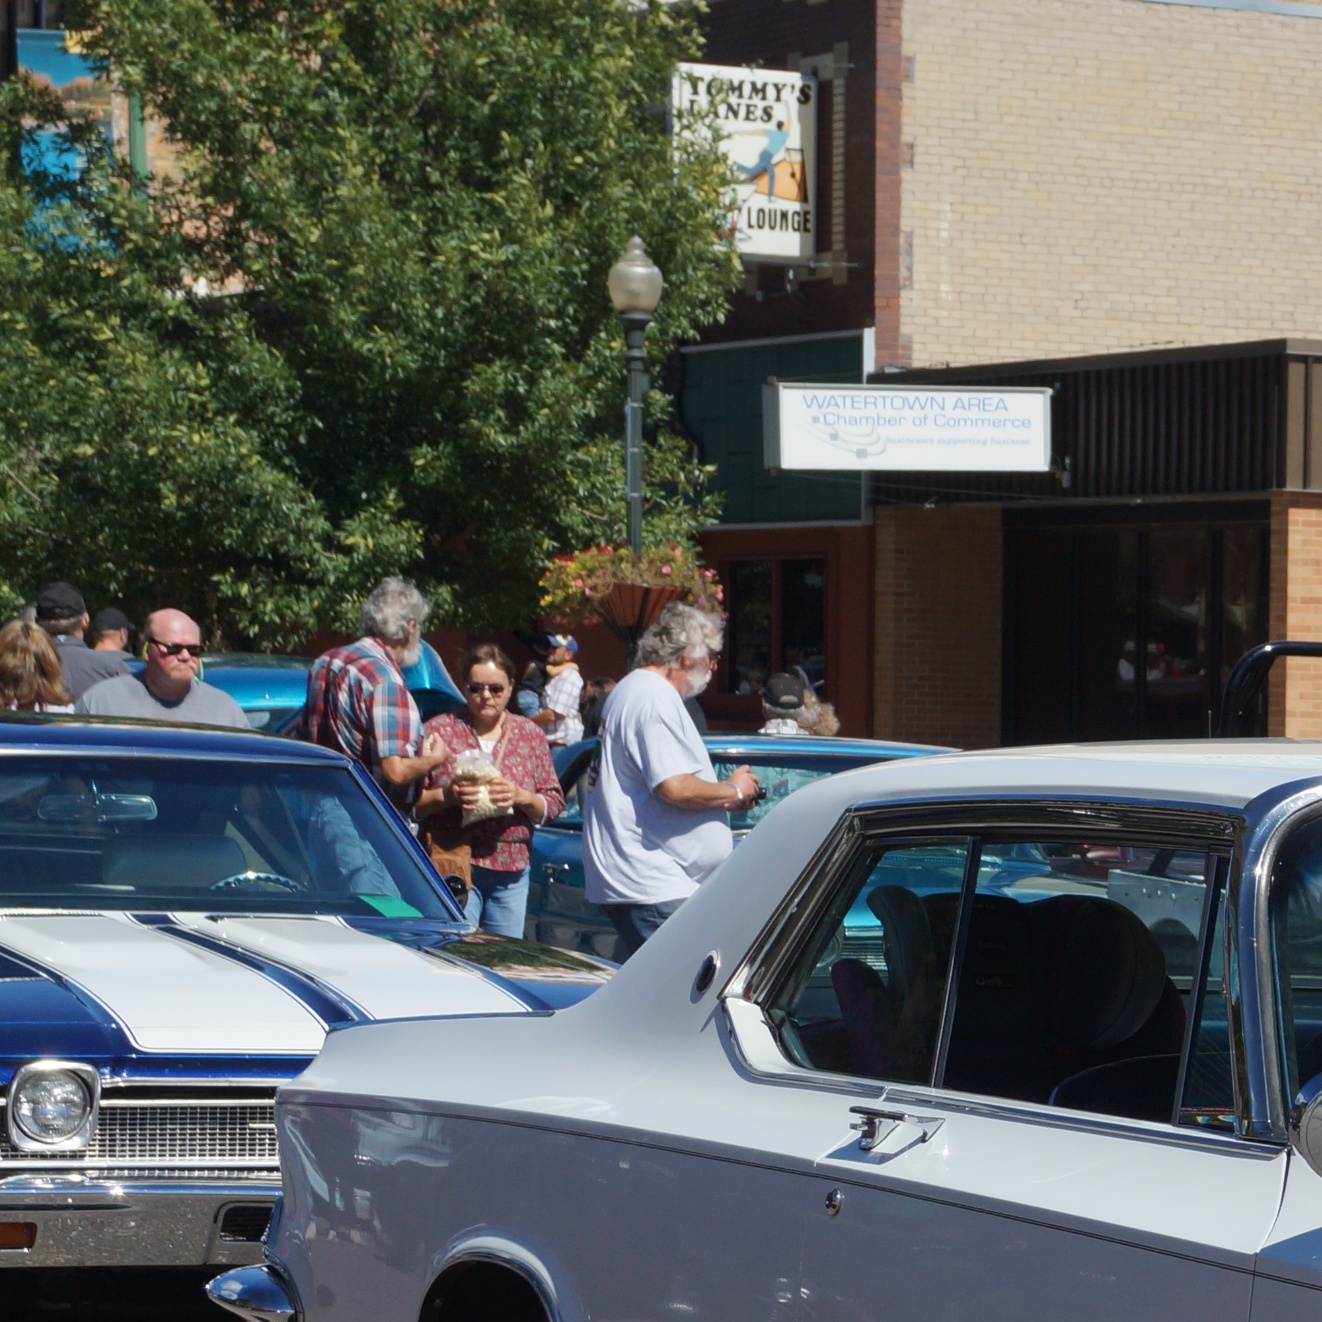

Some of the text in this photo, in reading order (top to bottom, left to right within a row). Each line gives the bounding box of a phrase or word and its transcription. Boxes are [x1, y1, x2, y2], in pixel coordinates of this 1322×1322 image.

[687, 76, 812, 105] TOMMY'S
[688, 99, 774, 123] LANES
[747, 207, 812, 233] LOUNGE
[803, 394, 1009, 412] WATERTOWN AREA
[823, 412, 1032, 428] Chamber of Commerce
[936, 437, 988, 447] supporting
